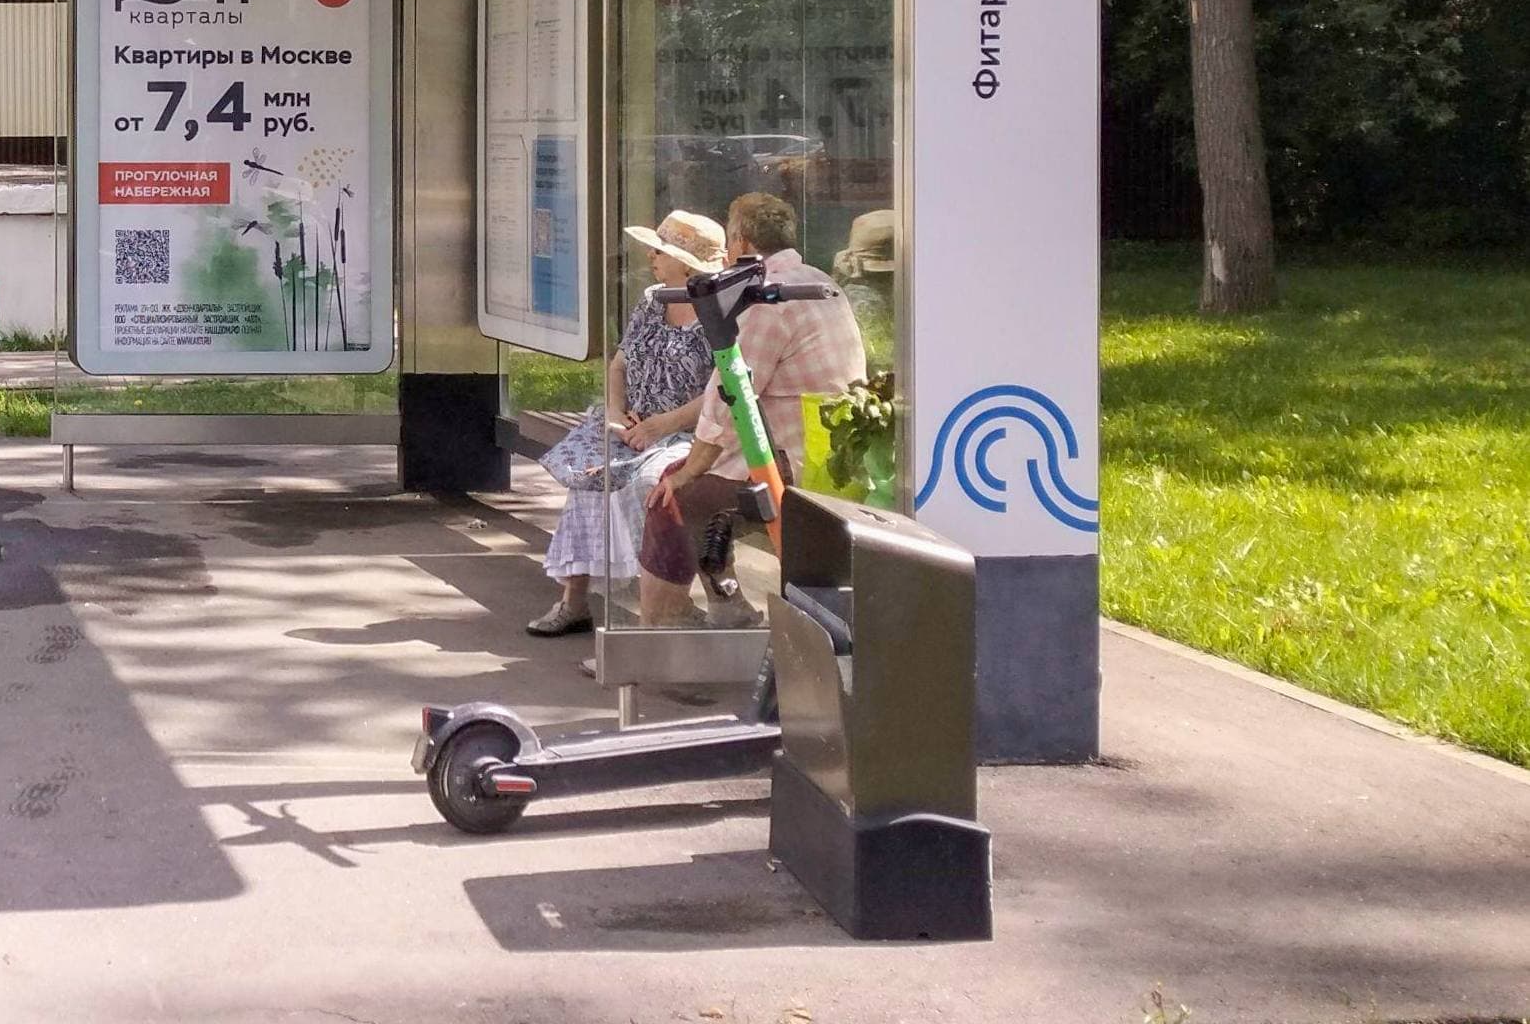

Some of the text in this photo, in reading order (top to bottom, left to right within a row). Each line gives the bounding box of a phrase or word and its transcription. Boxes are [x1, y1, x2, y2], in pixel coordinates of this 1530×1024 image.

[130, 11, 243, 29] кварталы
[114, 45, 353, 69] Квартиры в Москве
[114, 81, 311, 141] от 7,4 млн
[264, 112, 315, 137] руб.
[114, 170, 218, 182] ПРОГУЛОЧНАЯ
[114, 186, 211, 197] НАБЕРЕЖНАЯ
